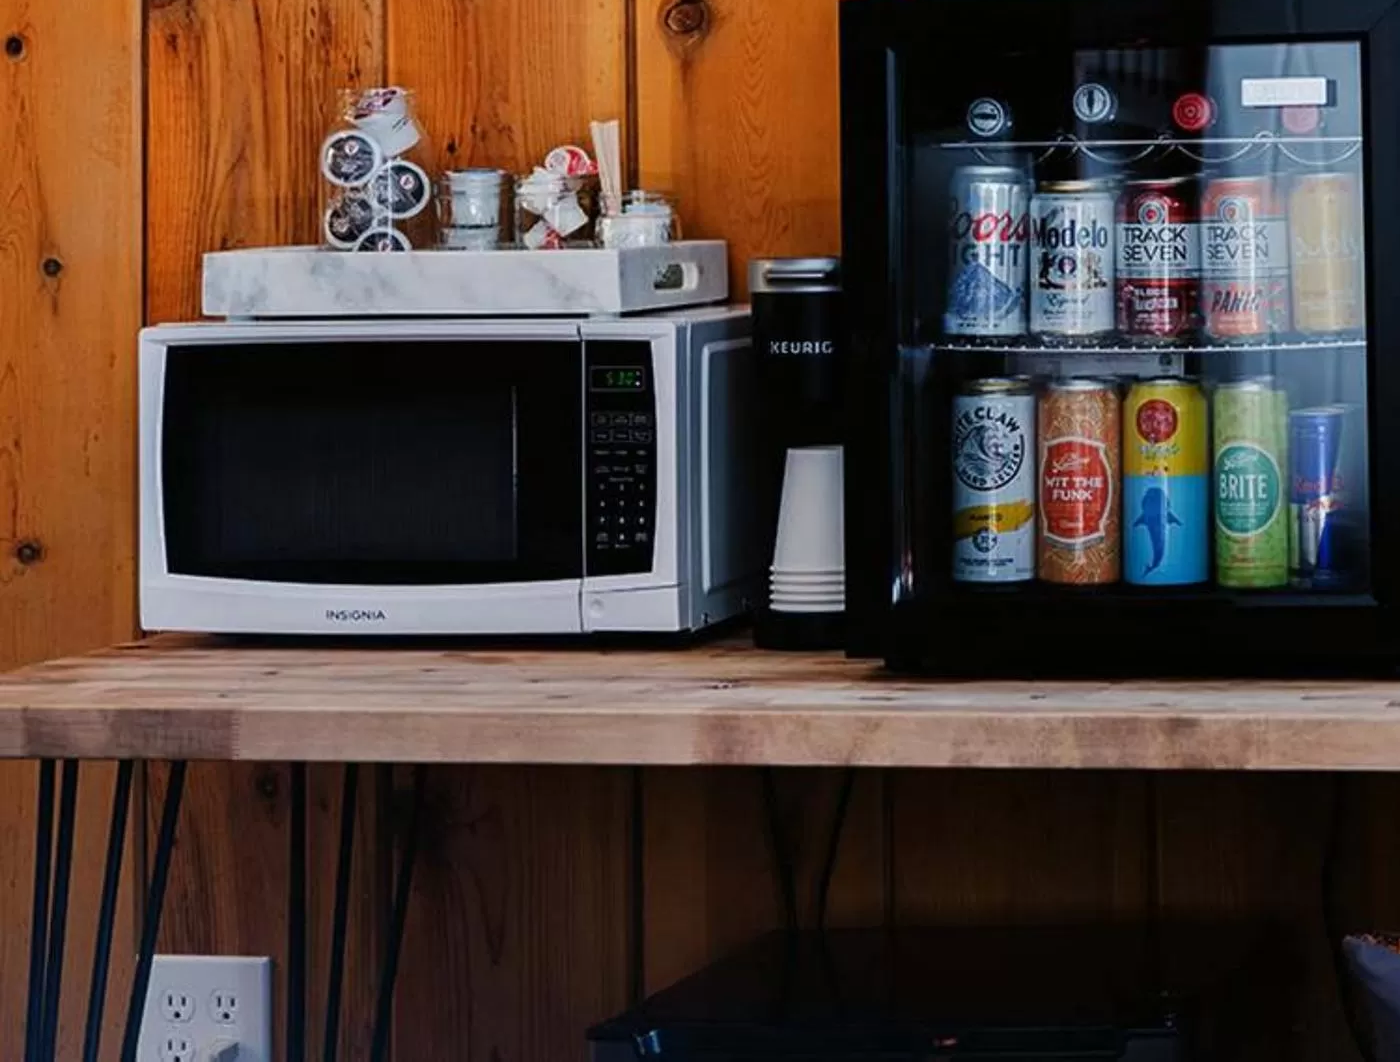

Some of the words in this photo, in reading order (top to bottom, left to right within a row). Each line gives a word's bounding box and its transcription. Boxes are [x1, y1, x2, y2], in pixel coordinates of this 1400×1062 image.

[1033, 212, 1108, 250] Modelo
[1122, 226, 1187, 243] TRACK
[1206, 226, 1268, 243] TRACK
[1123, 245, 1188, 261] SEVEN
[1206, 244, 1269, 260] SEVEN
[769, 340, 834, 355] KEURIG
[974, 406, 1021, 434] CLAW
[1219, 473, 1269, 499] BRITE
[1051, 488, 1095, 502] FUNK
[325, 609, 387, 621] INSIGNIA
